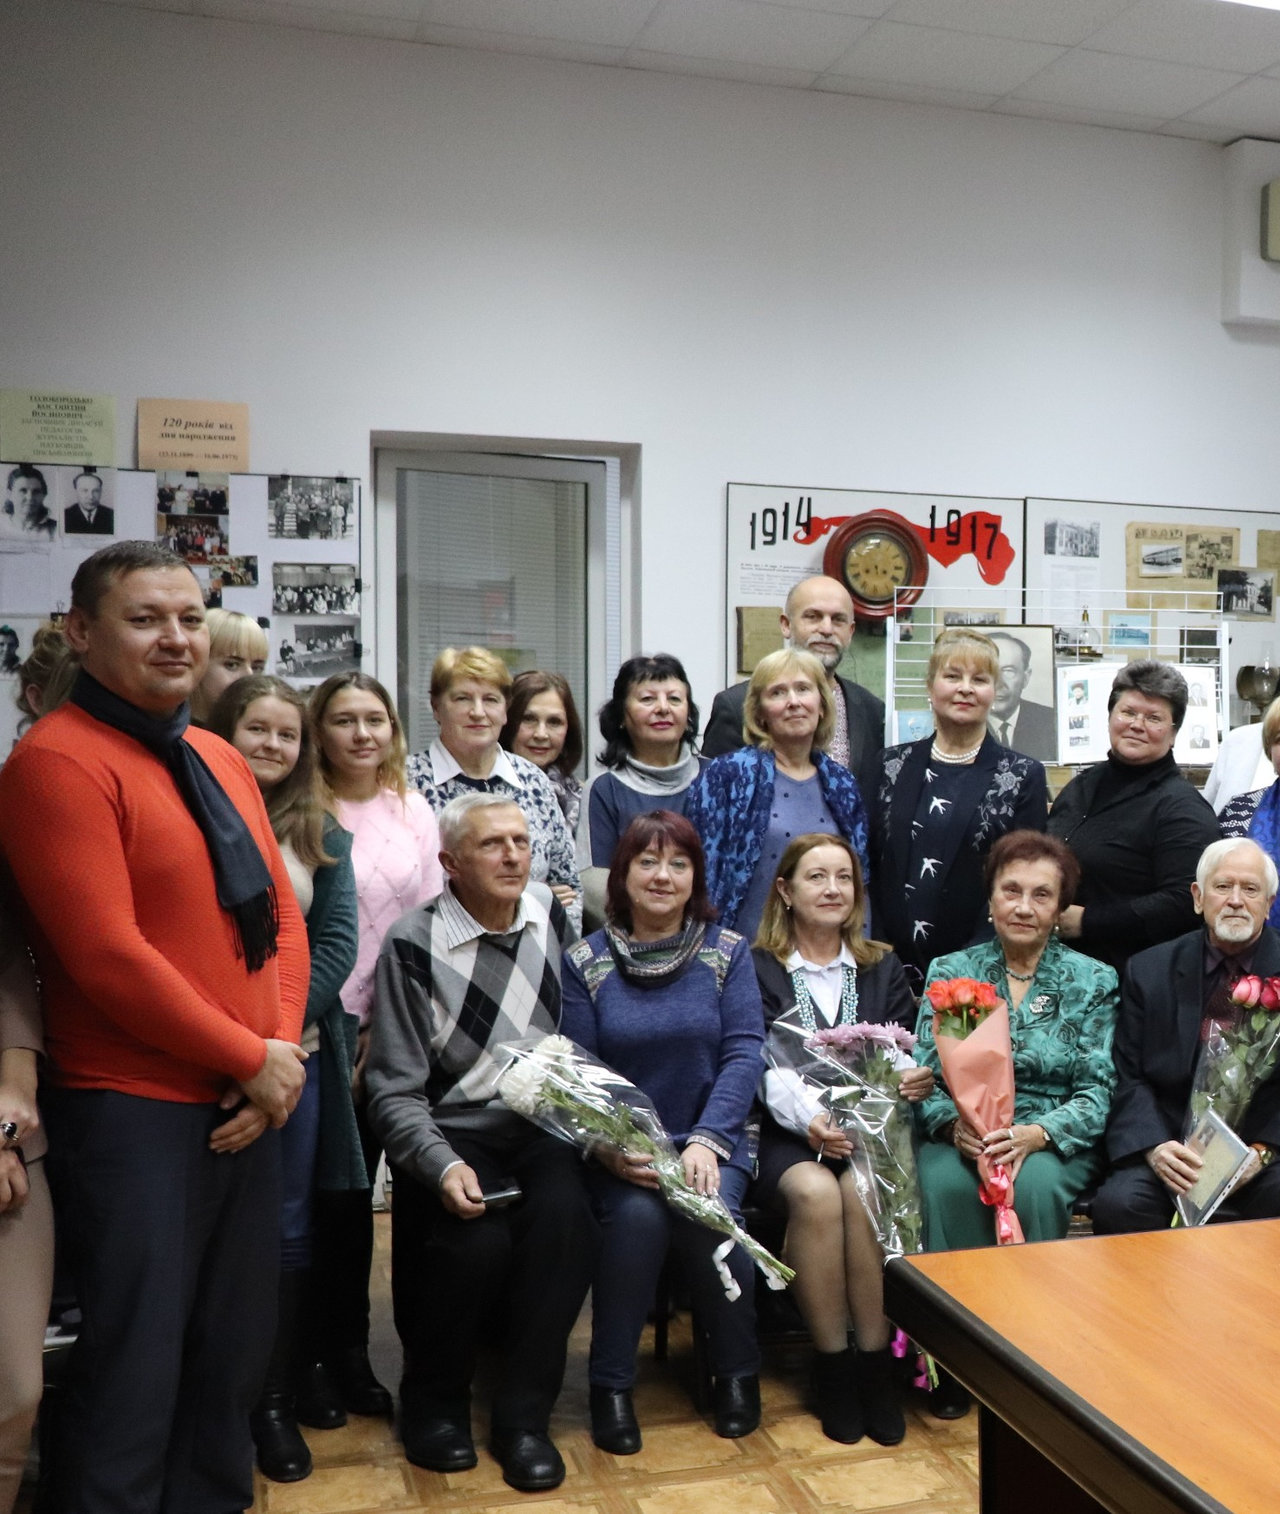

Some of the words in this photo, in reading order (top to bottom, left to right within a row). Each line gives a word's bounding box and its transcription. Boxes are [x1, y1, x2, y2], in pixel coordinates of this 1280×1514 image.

[160, 432, 176, 440] дня
[179, 433, 236, 442] народження
[162, 417, 182, 427] 120
[184, 418, 215, 430] років
[219, 422, 233, 430] від
[749, 496, 812, 550] 1914
[929, 505, 999, 560] 1917
